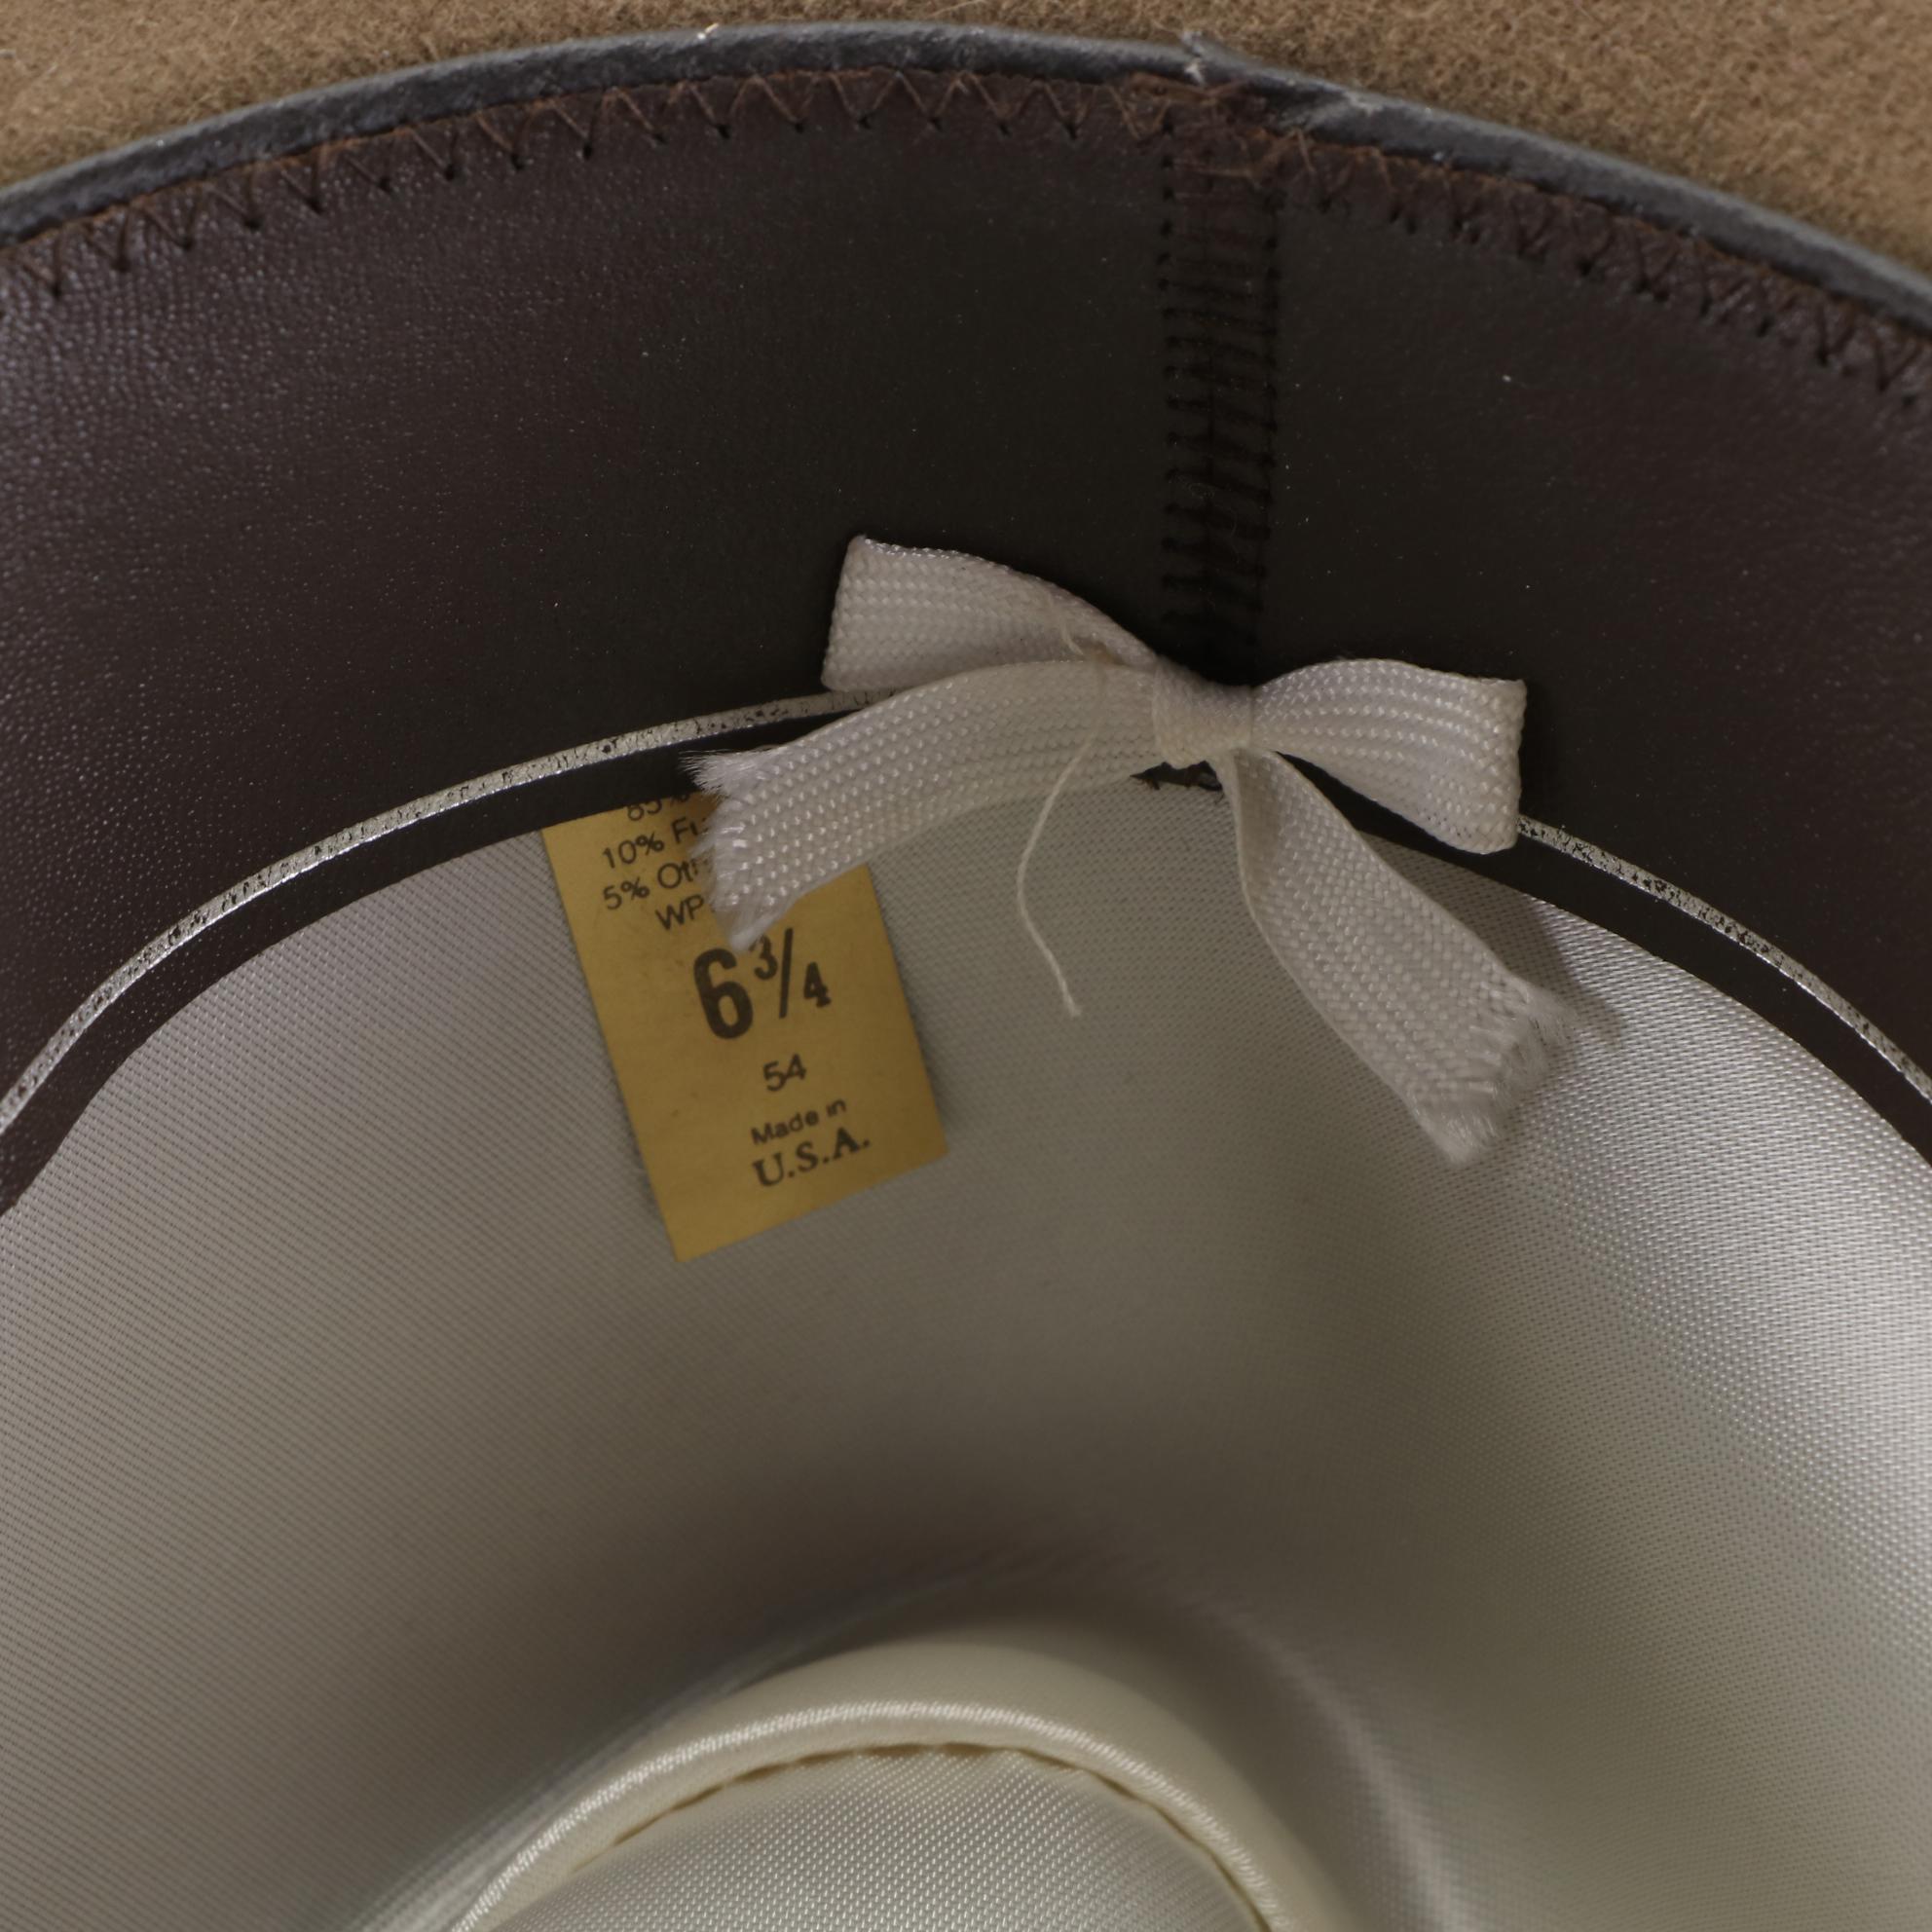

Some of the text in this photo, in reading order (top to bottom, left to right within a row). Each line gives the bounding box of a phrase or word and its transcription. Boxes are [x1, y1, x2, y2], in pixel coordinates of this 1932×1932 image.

[601, 832, 665, 870] 10%
[602, 876, 651, 911] 5%
[654, 893, 718, 932] WP
[762, 1053, 808, 1094] 54
[750, 1097, 848, 1146] Made in
[751, 1126, 872, 1188] U.S.A.
